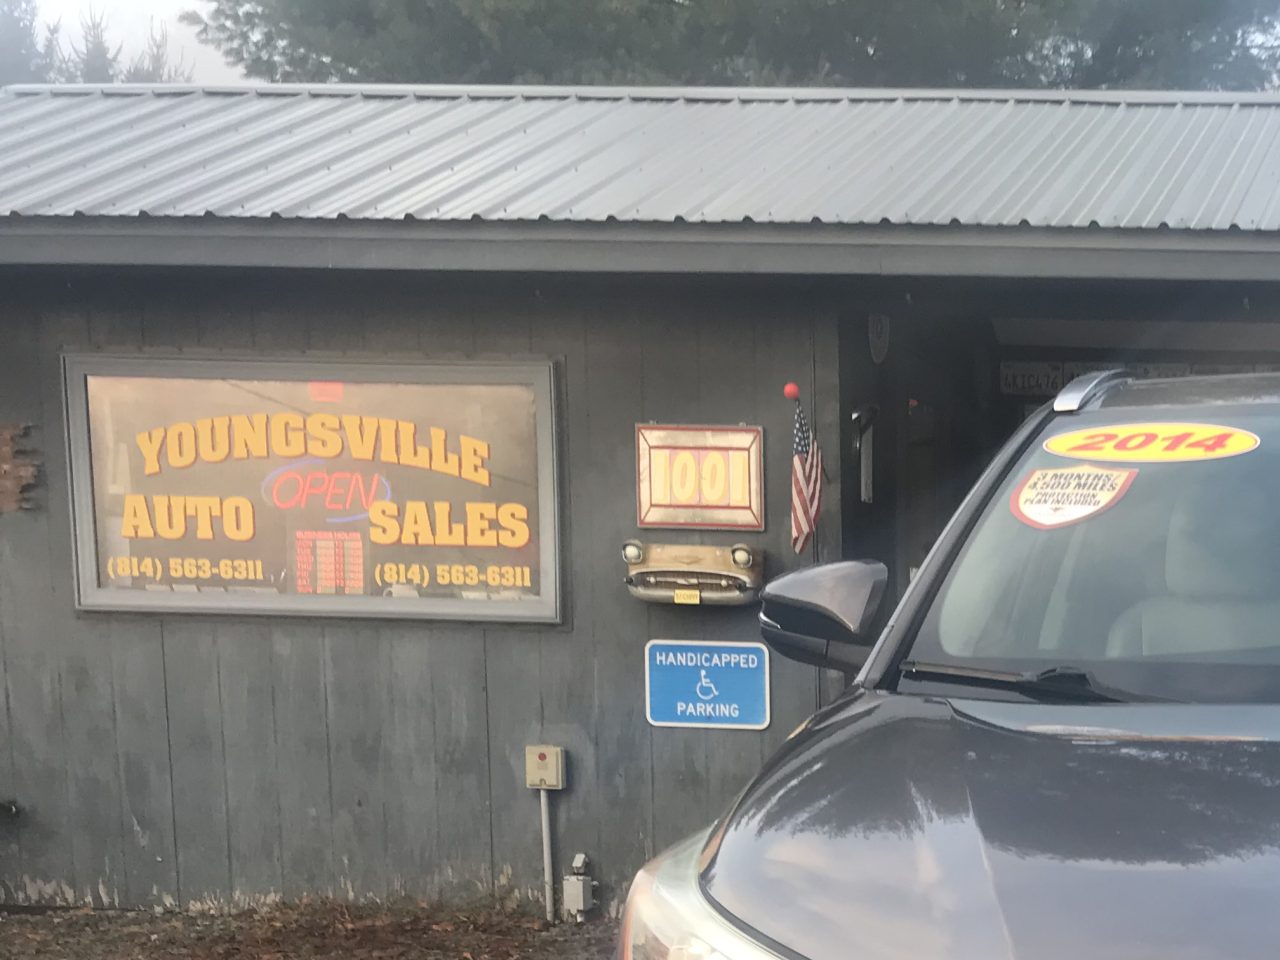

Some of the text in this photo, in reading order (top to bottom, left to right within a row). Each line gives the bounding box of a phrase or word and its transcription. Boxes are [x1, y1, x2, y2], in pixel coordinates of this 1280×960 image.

[136, 412, 492, 488] YOUNGSVILLE
[1065, 432, 1237, 453] 2014
[654, 448, 748, 506] 1001
[1073, 481, 1119, 492] MILES
[272, 470, 380, 511] OPEN
[1035, 491, 1098, 500] PROTECTION
[121, 494, 531, 549] AUTO SALES
[106, 555, 265, 582] (814) 563-6311
[374, 562, 430, 588] (814)
[436, 564, 532, 588] 563-6311
[655, 651, 759, 669] HANDICAPPED
[676, 701, 741, 719] PARKING
